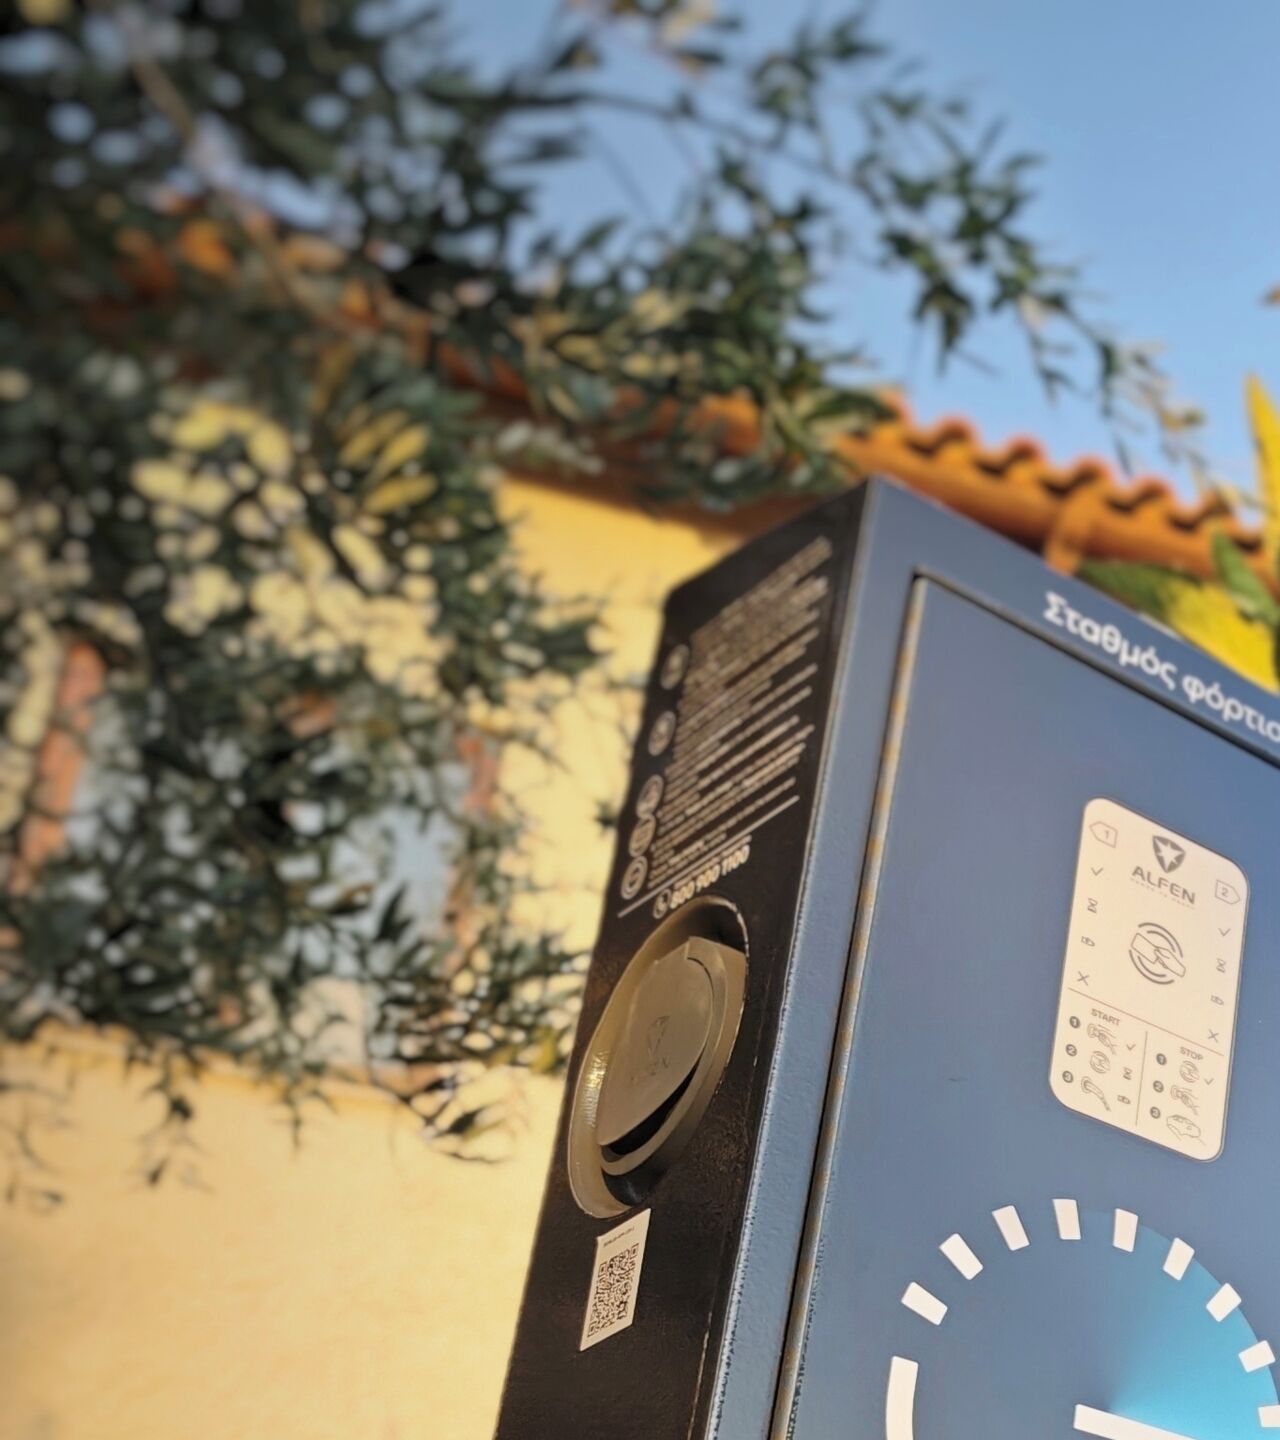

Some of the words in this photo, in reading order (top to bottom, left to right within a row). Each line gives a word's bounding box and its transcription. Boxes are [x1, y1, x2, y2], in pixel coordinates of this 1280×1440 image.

[1042, 590, 1178, 691] Σταθμός
[1131, 865, 1196, 905] ALFEN
[1091, 1008, 1120, 1026] START
